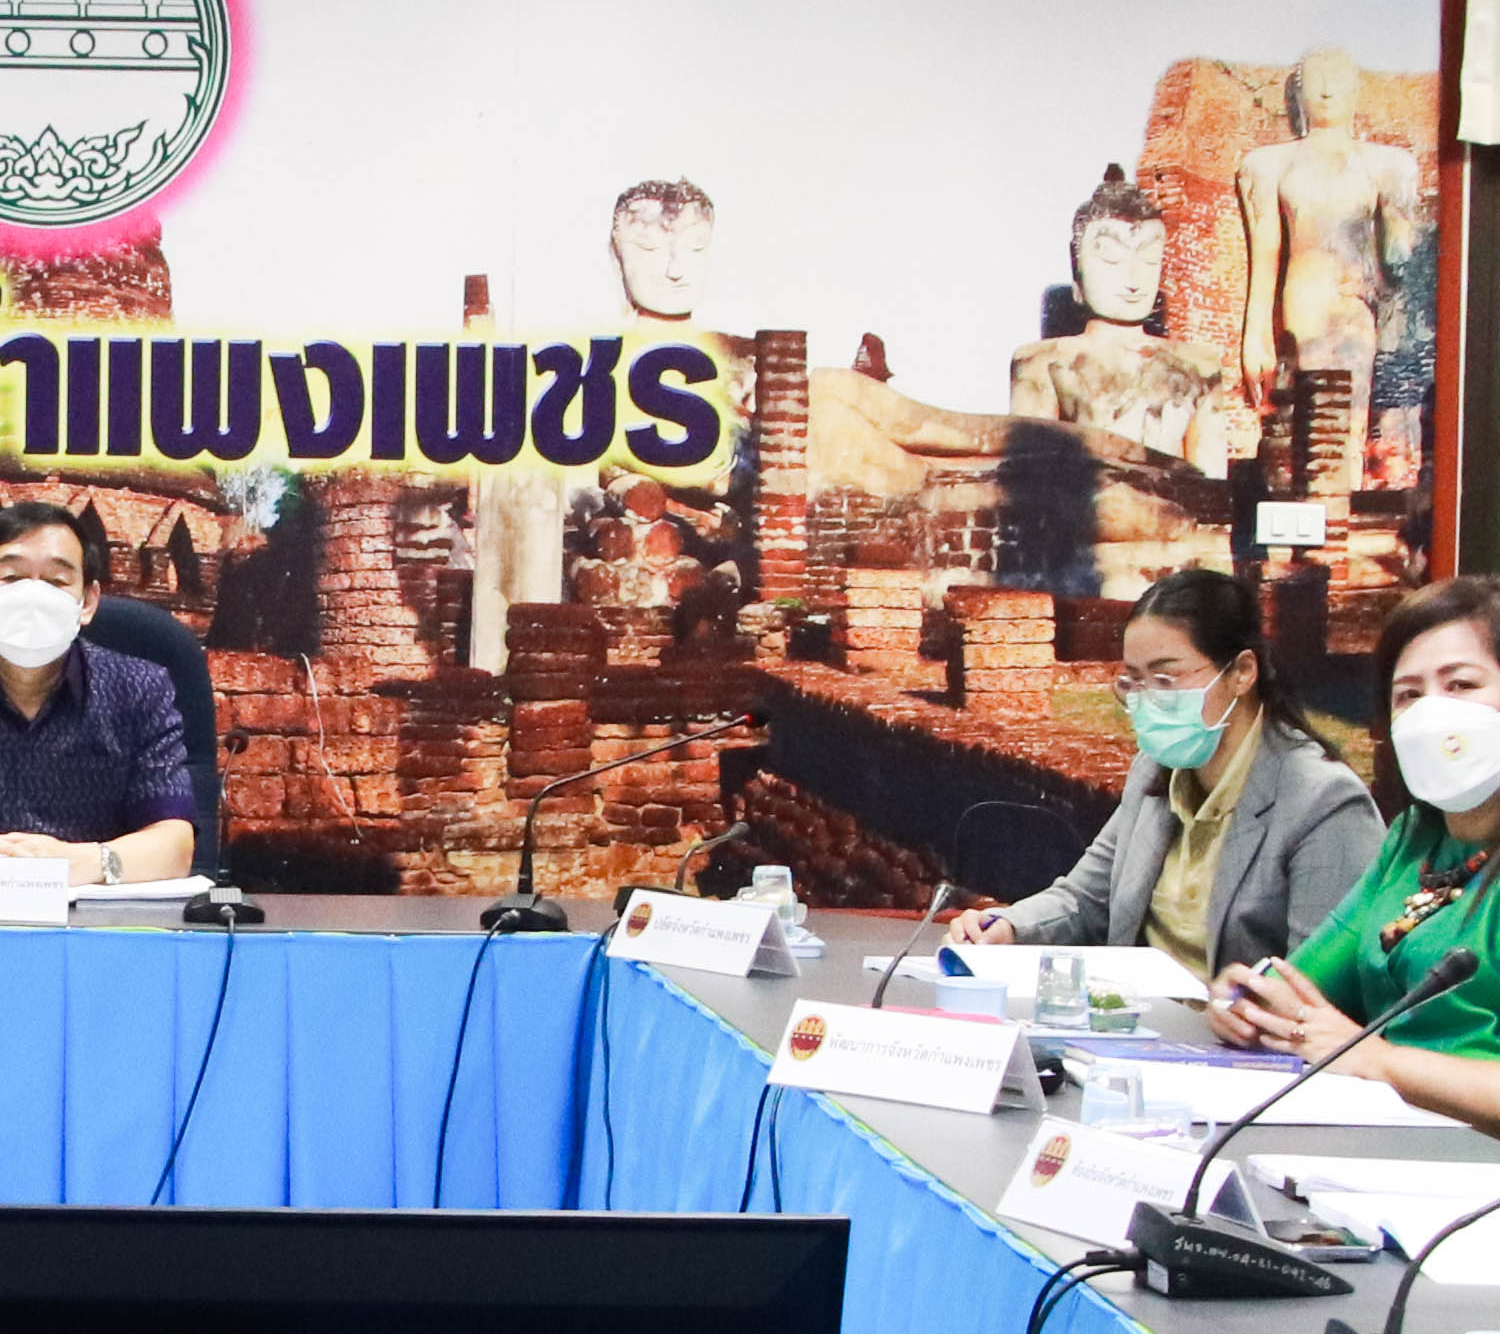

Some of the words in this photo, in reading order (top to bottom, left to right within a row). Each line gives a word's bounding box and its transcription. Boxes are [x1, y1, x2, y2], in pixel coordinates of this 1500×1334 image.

[828, 1031, 1003, 1073] พัฒนาการจังหวัดกำแพงเพชร
